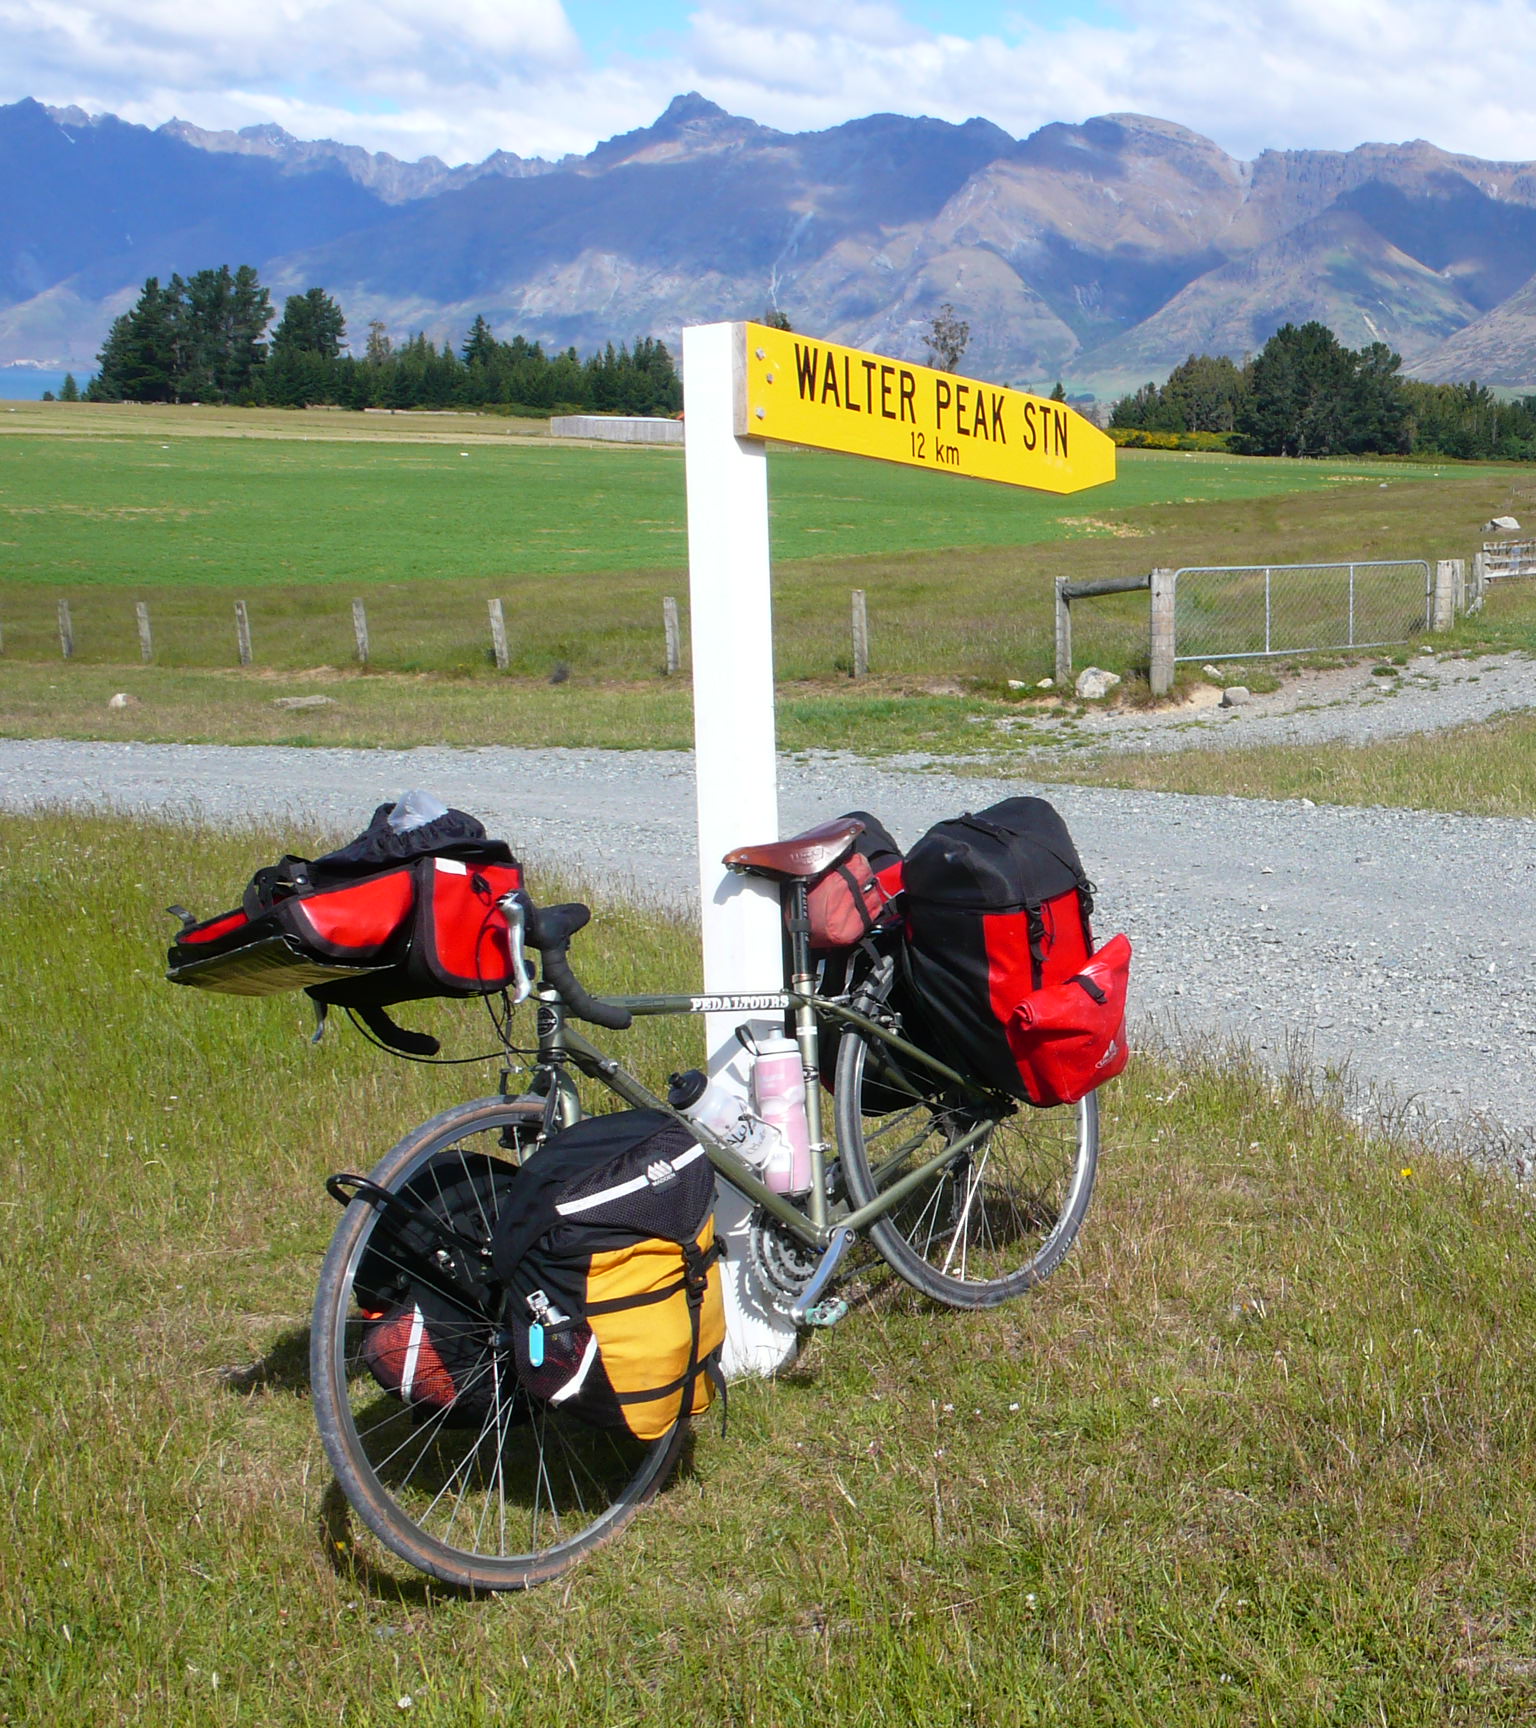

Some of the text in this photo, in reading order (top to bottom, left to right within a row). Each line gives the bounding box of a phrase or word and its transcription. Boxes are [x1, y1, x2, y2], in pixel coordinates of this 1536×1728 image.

[794, 343, 1068, 458] WALTER PEAK STN
[911, 431, 960, 466] 12 km
[690, 995, 790, 1011] PEDALTOURS
